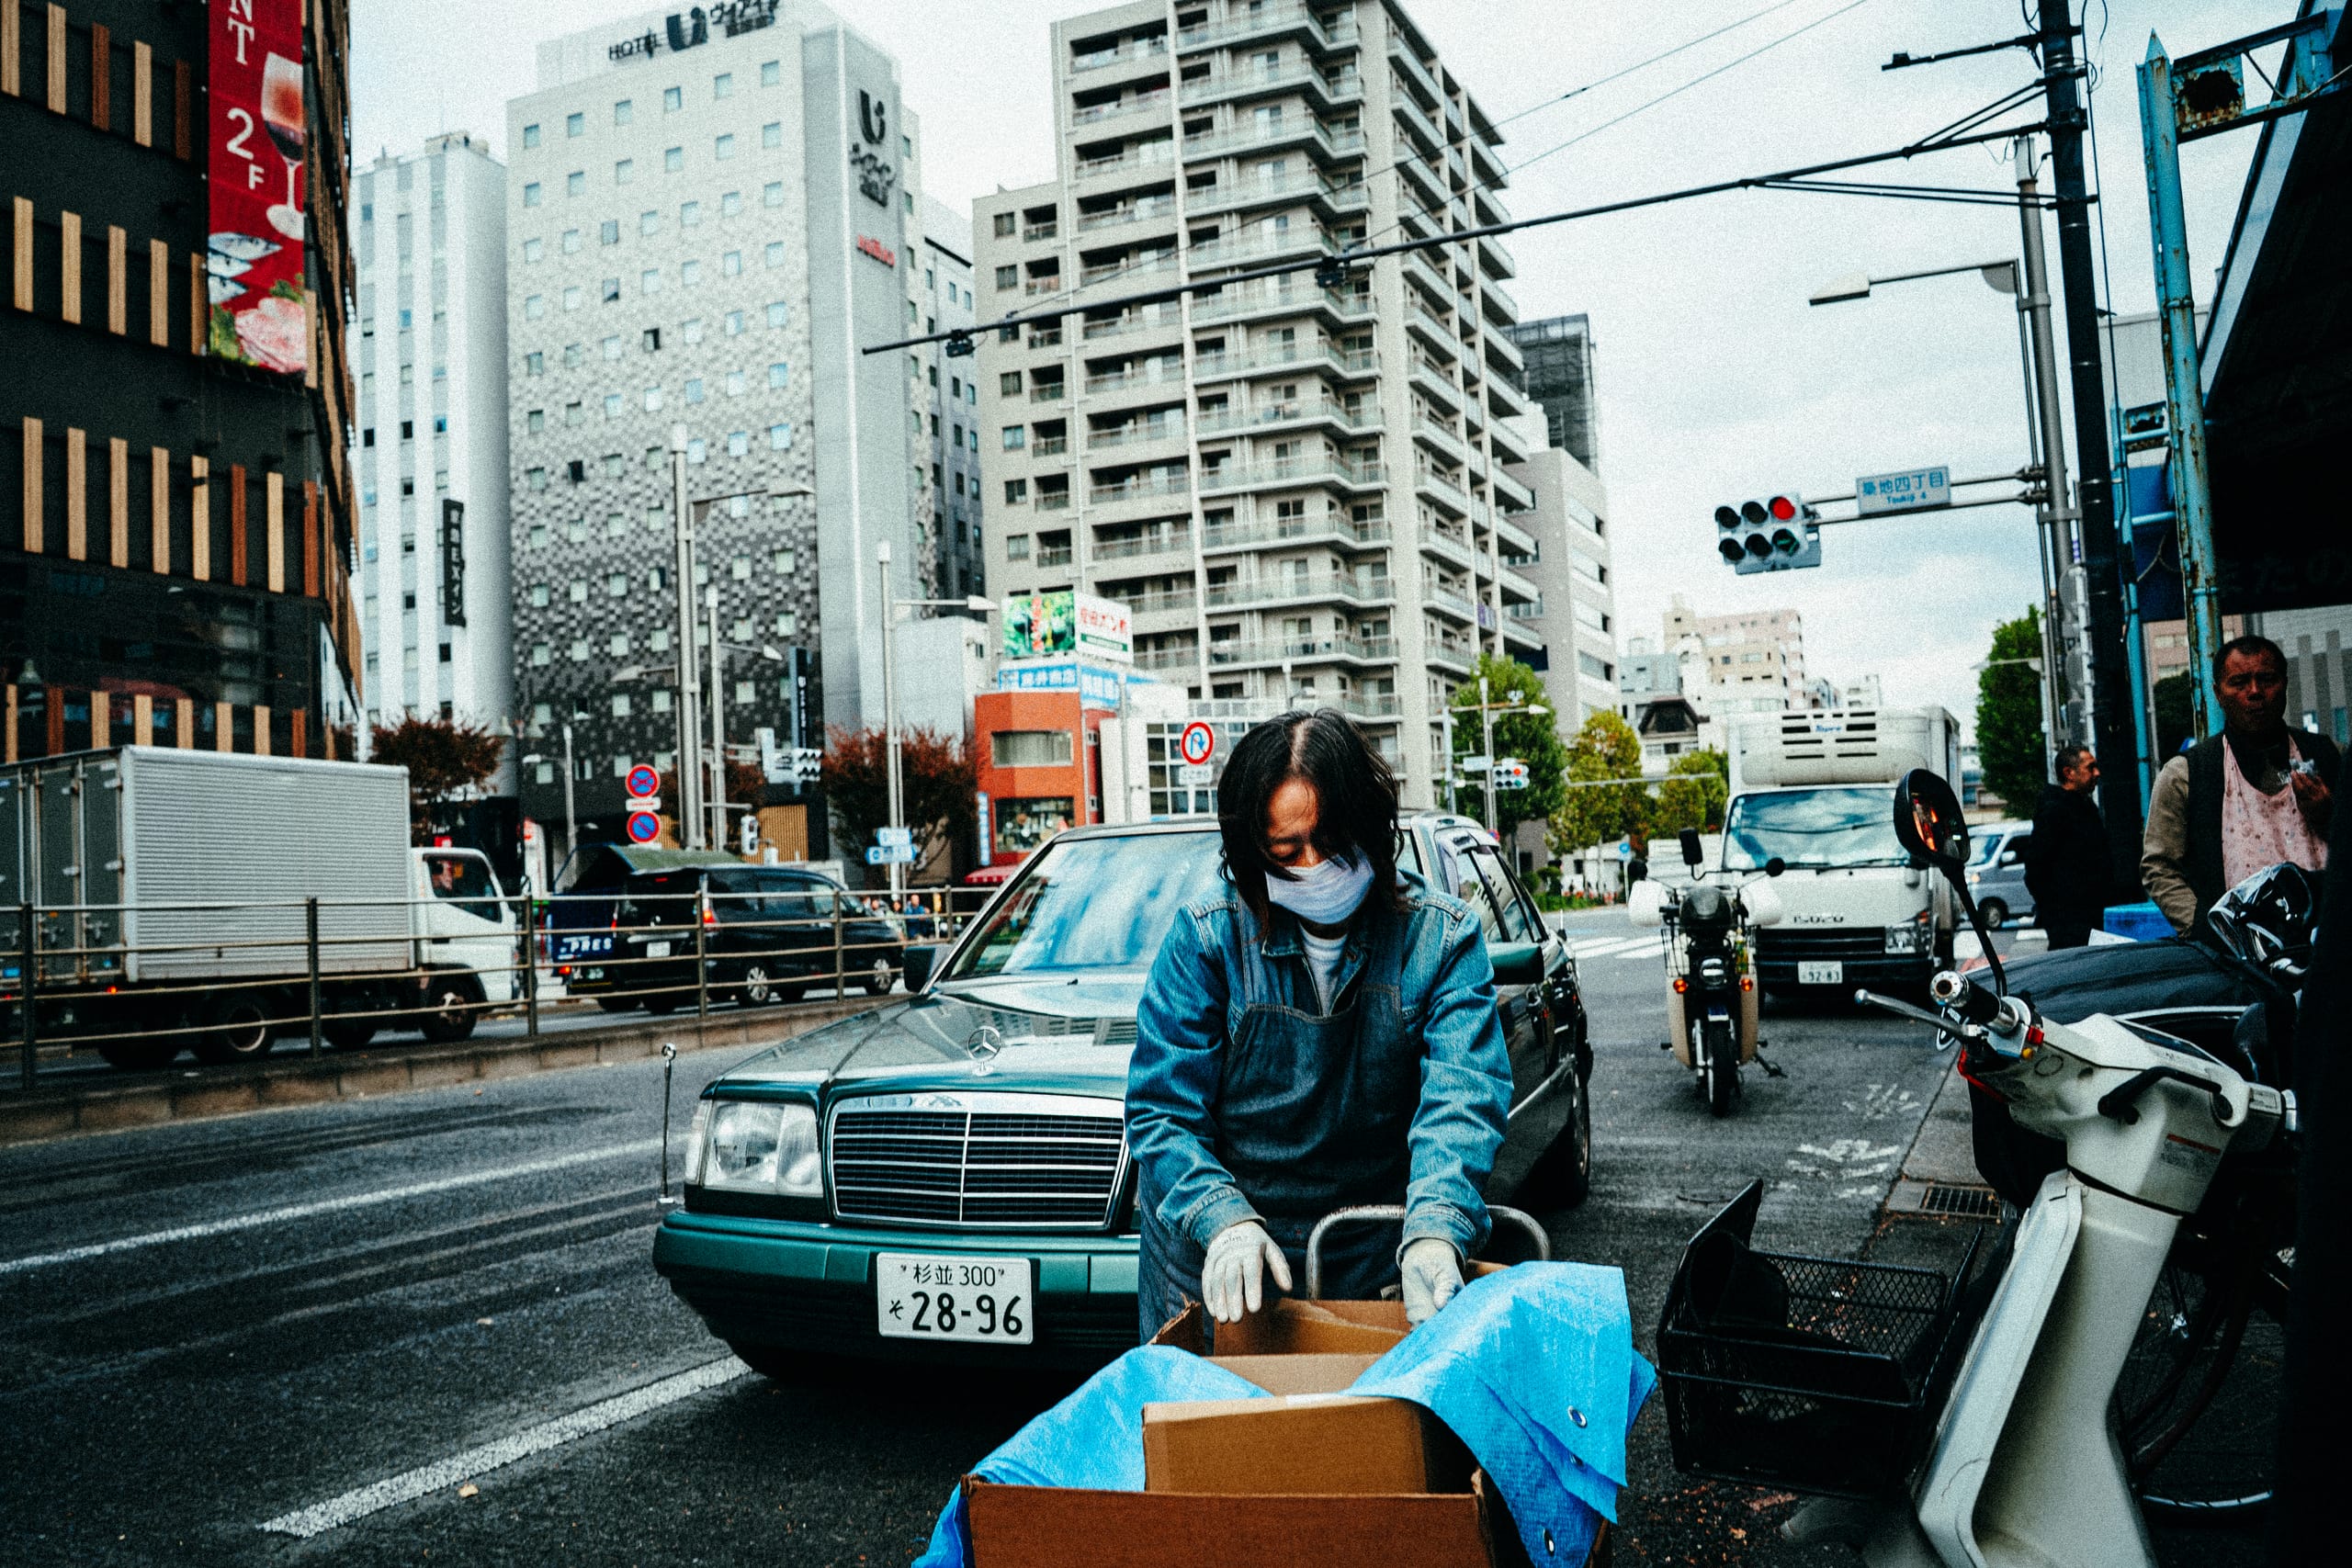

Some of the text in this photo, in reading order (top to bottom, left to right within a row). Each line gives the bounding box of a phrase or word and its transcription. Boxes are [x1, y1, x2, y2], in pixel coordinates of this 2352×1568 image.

[913, 1263, 997, 1287] 杉並 300
[888, 1291, 1023, 1336] そ 28-96
